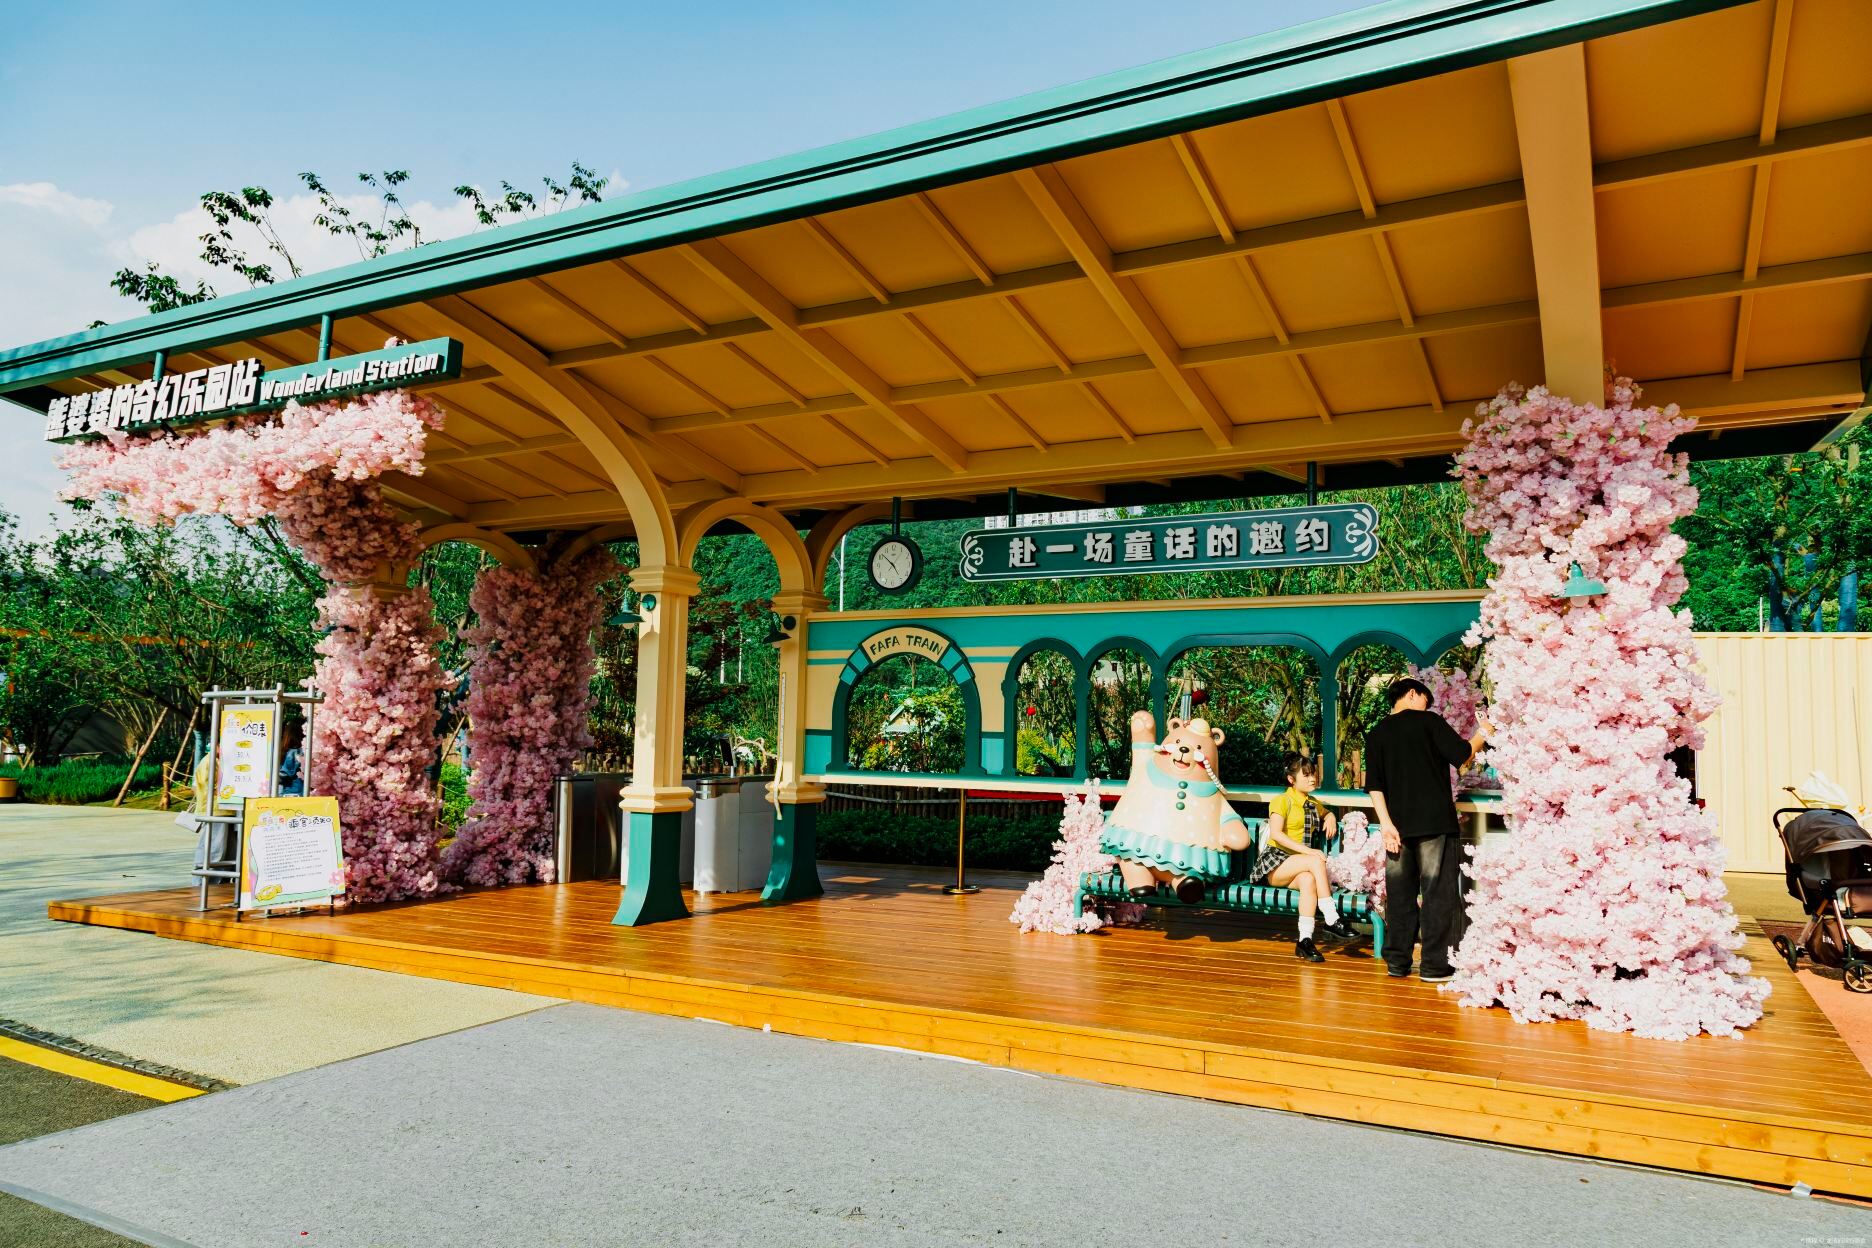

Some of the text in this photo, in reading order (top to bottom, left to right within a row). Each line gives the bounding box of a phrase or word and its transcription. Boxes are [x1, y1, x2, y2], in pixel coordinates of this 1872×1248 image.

[260, 352, 439, 400] Wonderland Station
[1008, 517, 1329, 568] 赴一场童话的邀约
[870, 634, 943, 655] FAFA TRAIN
[241, 722, 267, 738] 价目表
[288, 816, 332, 829] 乘客须知
